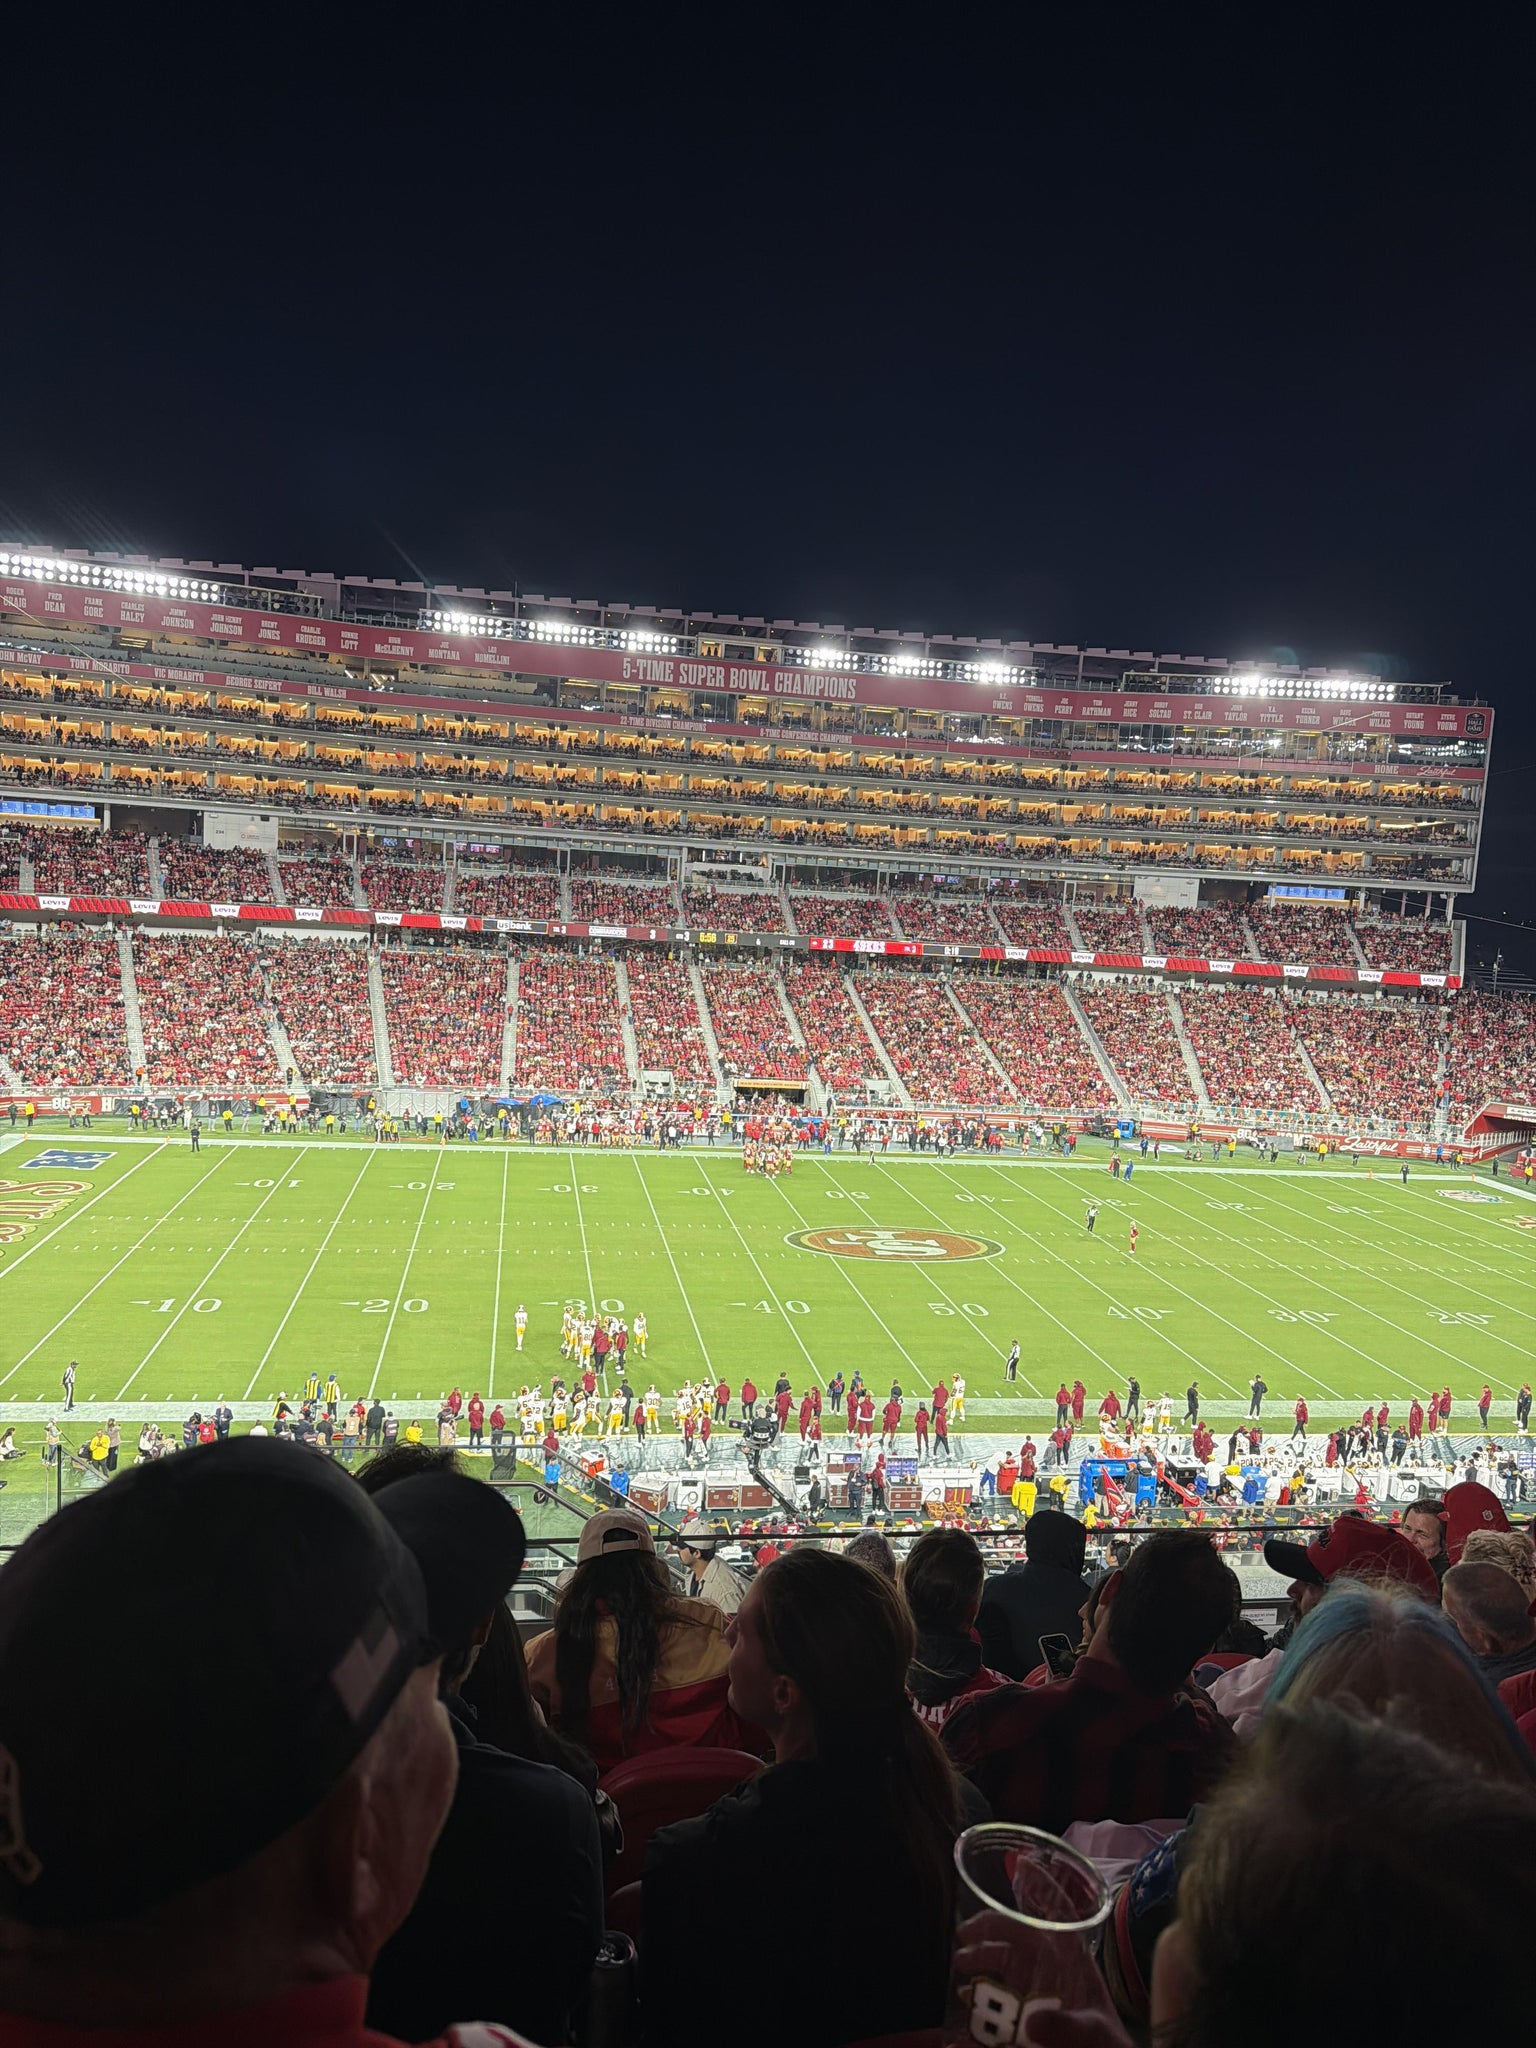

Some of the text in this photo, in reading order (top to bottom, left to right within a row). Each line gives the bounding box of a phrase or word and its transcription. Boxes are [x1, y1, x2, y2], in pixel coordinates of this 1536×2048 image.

[4, 596, 26, 608] CRAIG
[45, 600, 65, 613] DEAN
[85, 597, 103, 606] FRANK
[121, 601, 144, 611] CHARLES
[84, 606, 103, 617] GORE
[120, 610, 144, 623] HALEY
[169, 608, 186, 616] JIMMY
[161, 616, 194, 629] JOHNSON
[210, 622, 242, 635] JOHNSON
[258, 629, 280, 640] JONES
[296, 633, 326, 646] KRUEGER
[341, 639, 358, 650] LOTT
[375, 644, 414, 656] McELHENNY
[0, 651, 41, 664] OHN McVAY
[428, 648, 460, 661] MONTANA
[474, 653, 510, 665] NOMELLINI
[70, 658, 130, 674] TONY MORABITO
[155, 667, 204, 682] VIC MORABITO
[623, 657, 857, 700] 5-TIME SUPER BOWL CHAMPIONS
[226, 675, 282, 691] GEORGE SEIFERT
[308, 685, 346, 698] BILL WALSH
[993, 700, 1013, 710] OWENS
[1024, 703, 1044, 713] OWENS
[1055, 705, 1073, 715] PERRY
[1082, 706, 1112, 716] RATHMAN
[1123, 708, 1137, 718] RICE
[1149, 709, 1172, 719] SOLTAU
[1183, 711, 1213, 720] ST. CLAIR
[1224, 712, 1248, 721] TAYLOR
[1260, 714, 1283, 723] TITTLE
[620, 716, 707, 732] 22-TIME DIVISION CHAMPIONS
[1296, 715, 1320, 724] TURNER
[1369, 718, 1391, 728] WILLIS
[1404, 720, 1424, 729] YOUNG
[1437, 721, 1458, 731] YOUNG
[782, 730, 819, 741] CONFERENCE
[819, 732, 852, 744] CHAMPIONS
[1375, 765, 1399, 774] HOME
[1340, 1136, 1398, 1155] Faithful
[151, 1298, 223, 1313] 10
[361, 1298, 429, 1313] 20
[564, 1299, 625, 1313] 30
[752, 1300, 812, 1314] 40
[927, 1302, 989, 1317] 50
[1106, 1305, 1163, 1320] 40
[1267, 1309, 1331, 1323] 30
[1425, 1311, 1492, 1326] 20
